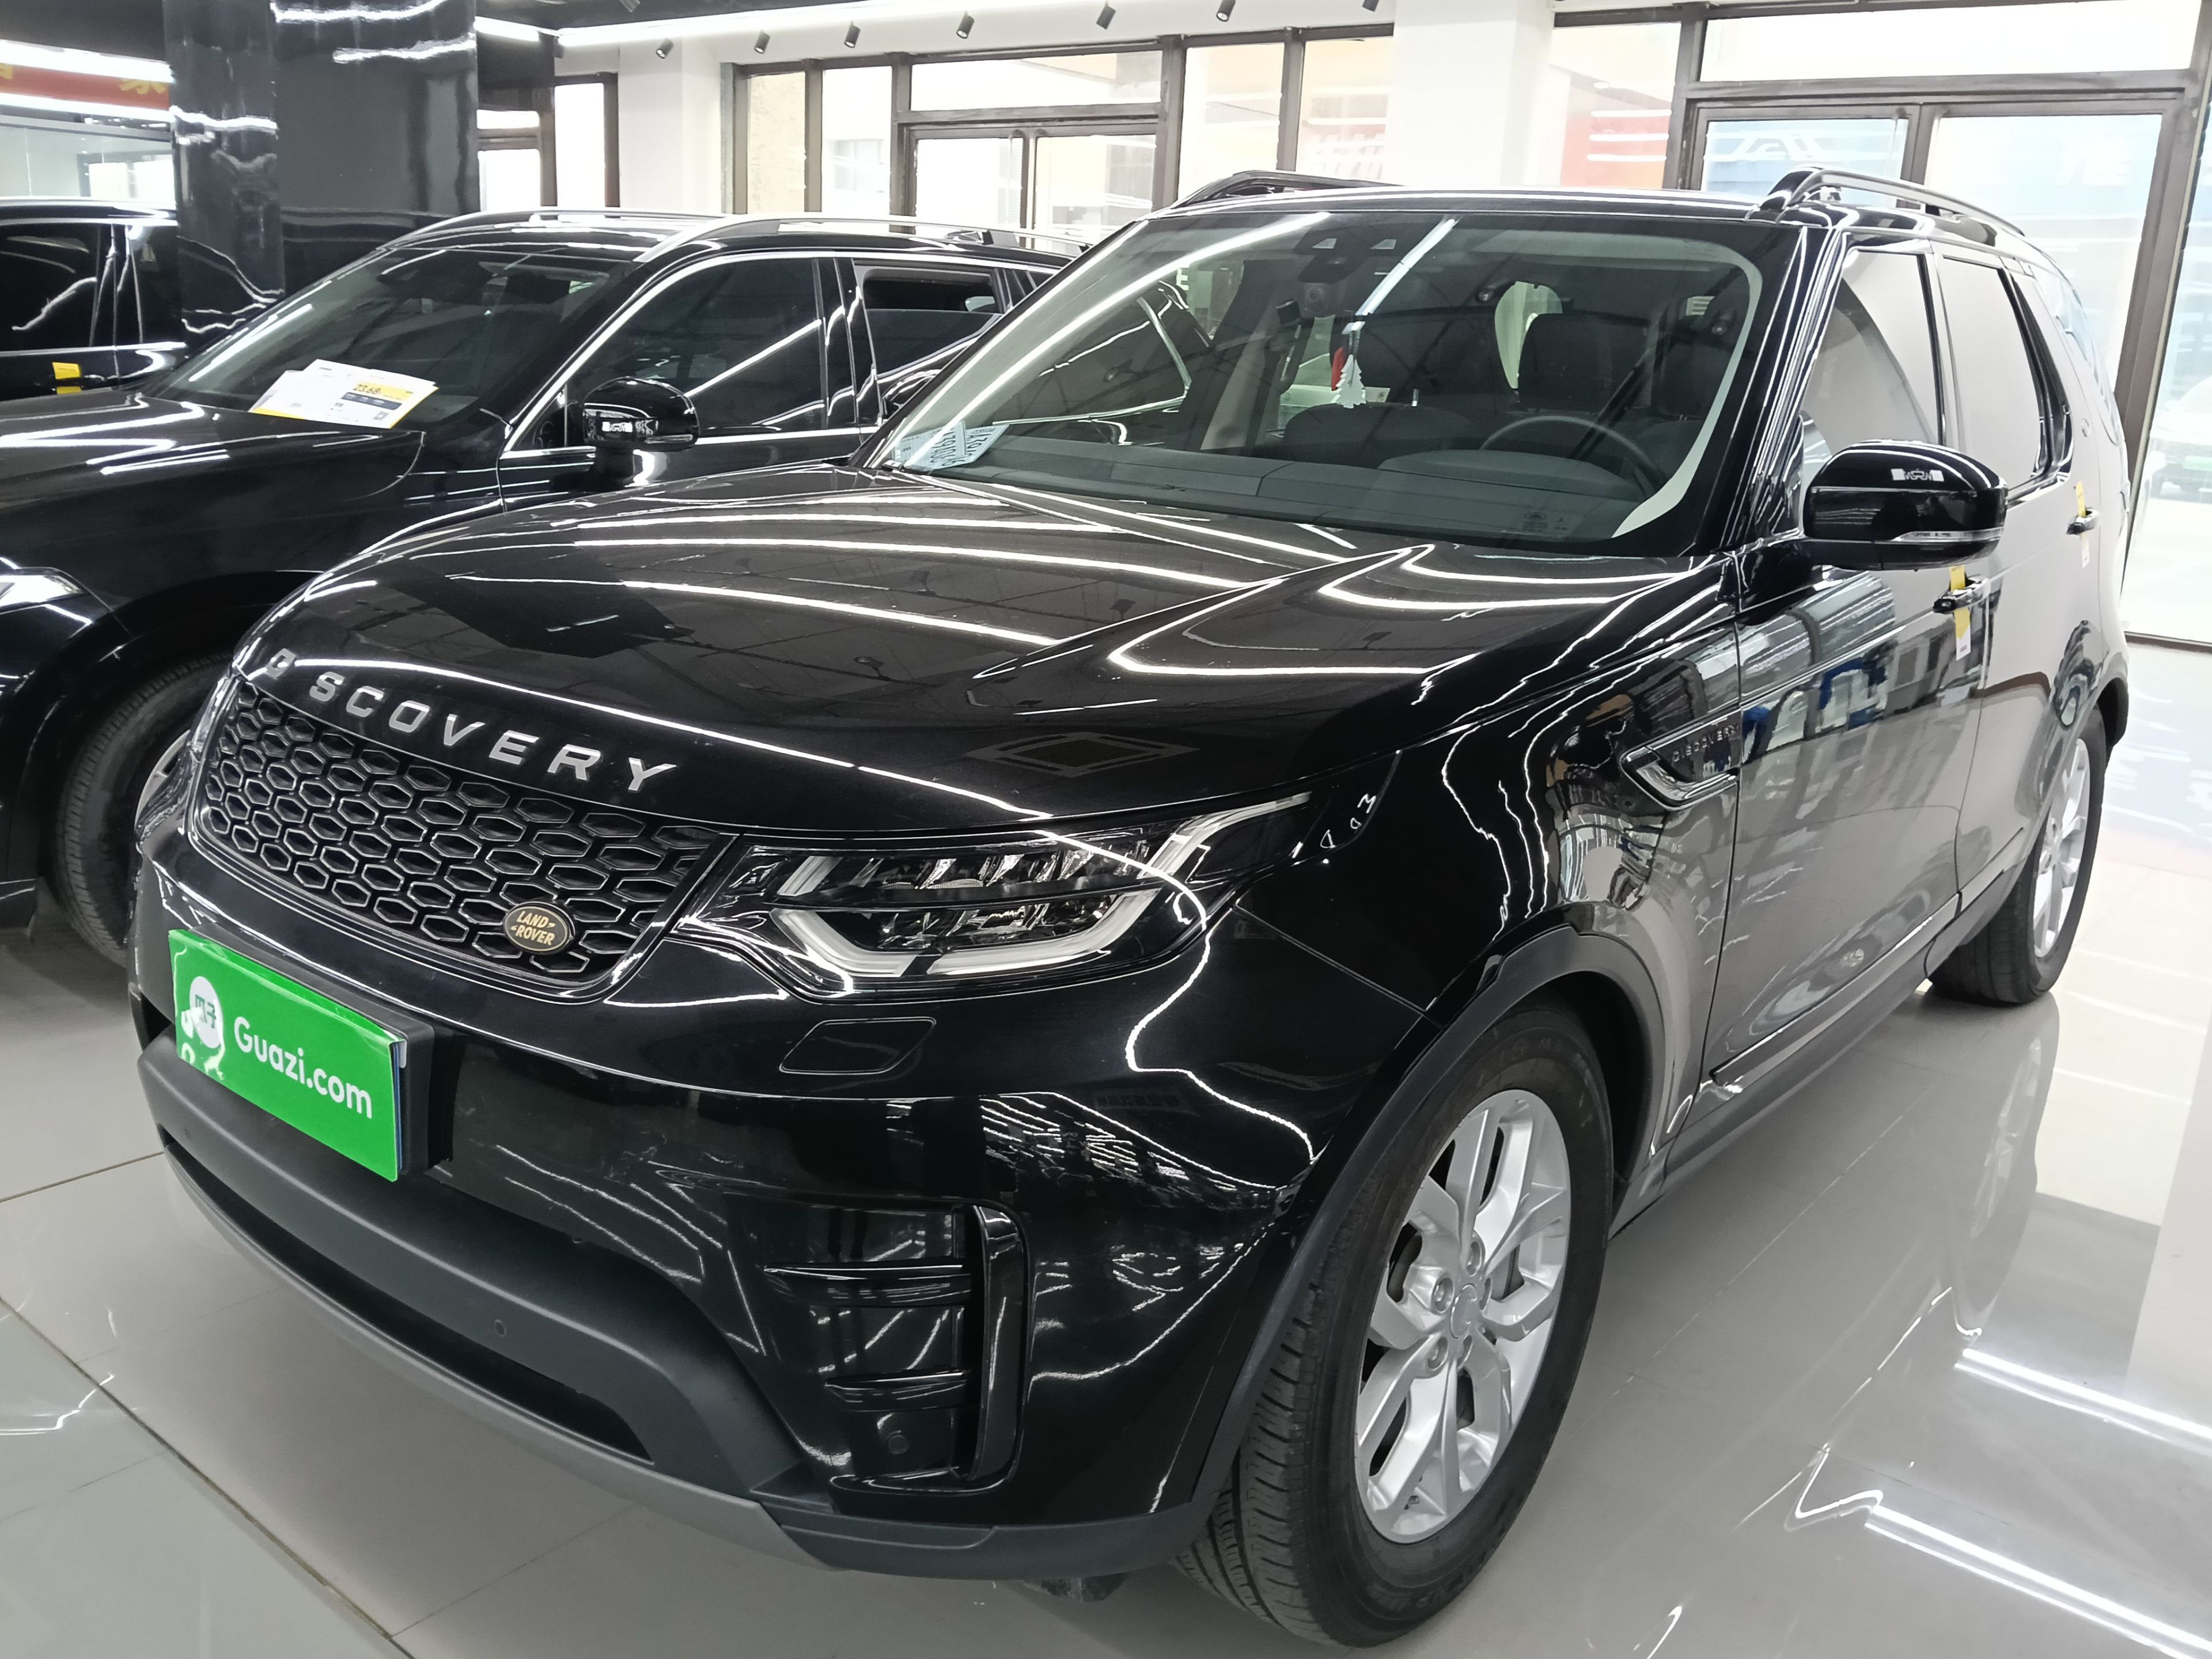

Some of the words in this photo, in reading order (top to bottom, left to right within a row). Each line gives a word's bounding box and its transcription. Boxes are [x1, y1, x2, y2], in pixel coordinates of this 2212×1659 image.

[265, 647, 678, 793] DSCOVERY
[1672, 723, 1739, 763] DISCOVERY
[515, 925, 555, 945] ROVER
[516, 910, 550, 928] LAND
[234, 1016, 373, 1119] Guazi.com
